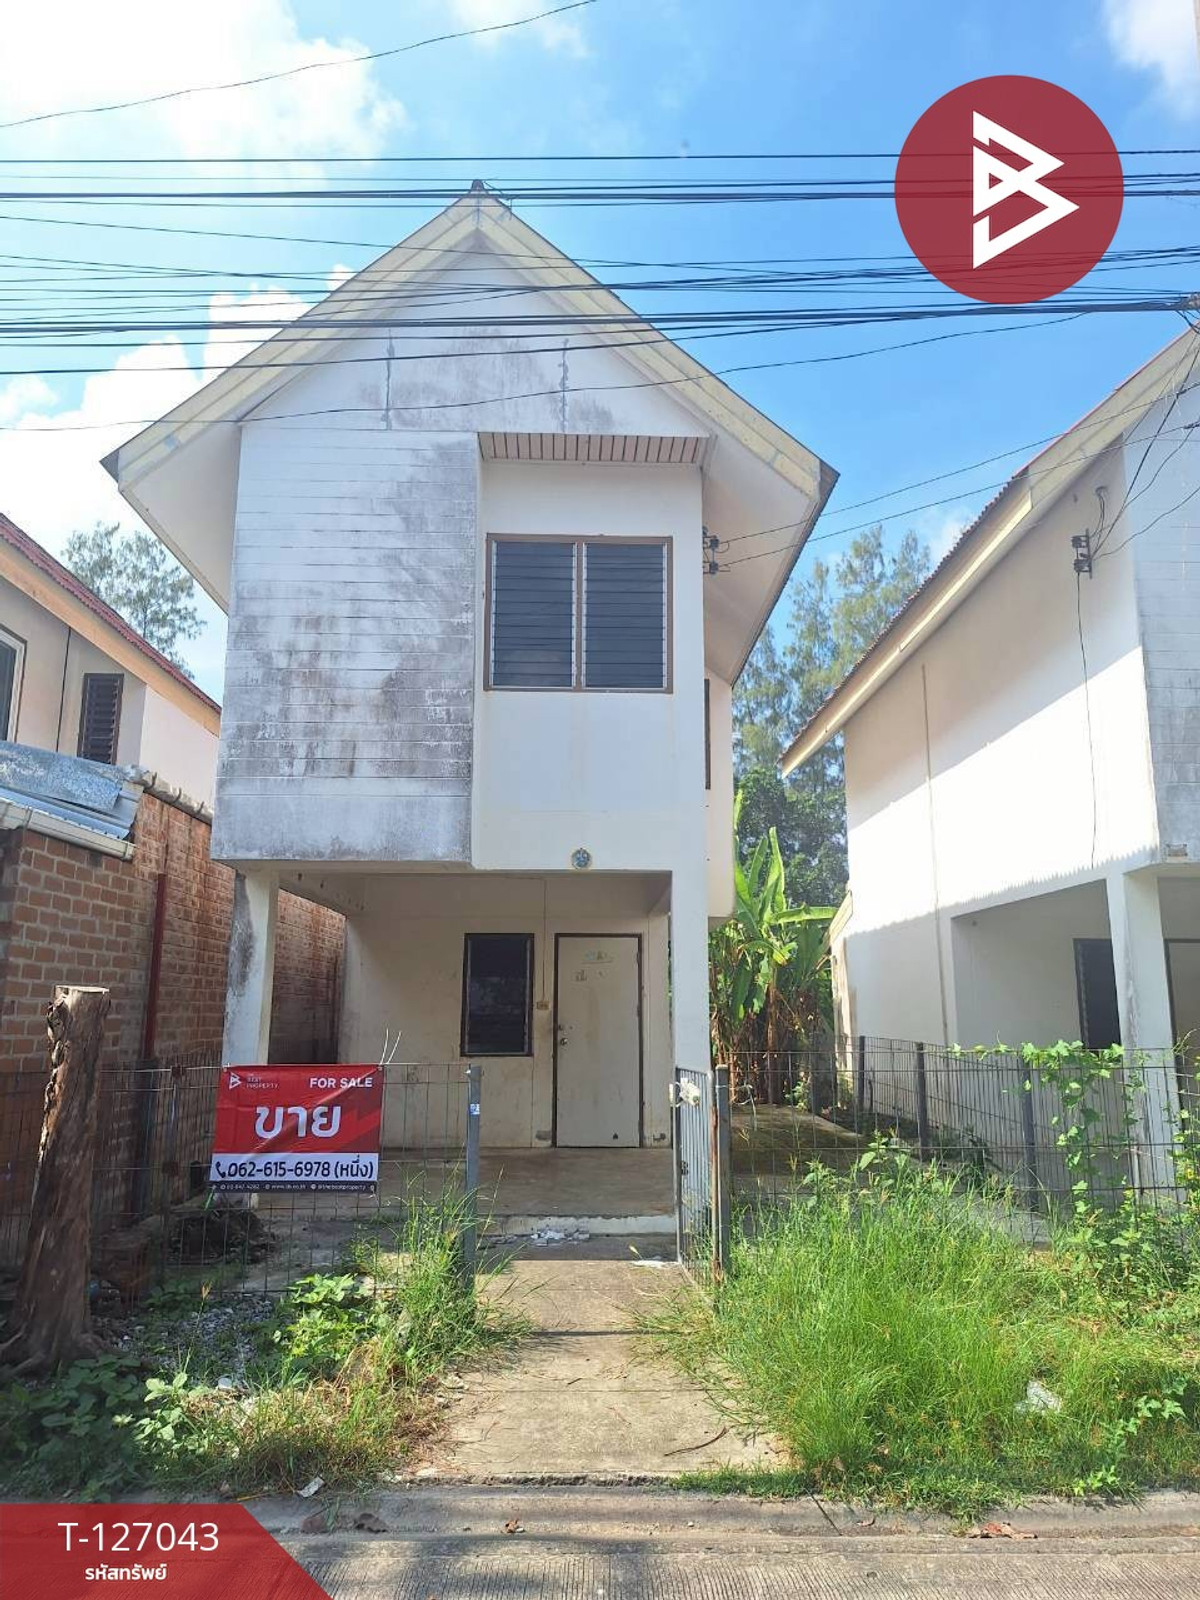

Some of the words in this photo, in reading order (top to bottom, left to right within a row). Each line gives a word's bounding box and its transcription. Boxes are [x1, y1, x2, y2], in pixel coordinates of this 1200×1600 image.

[310, 1077, 336, 1088] FOR
[339, 1077, 373, 1089] SALE
[255, 1106, 341, 1138] ขาย
[227, 1161, 330, 1178] 062-615-6978
[334, 1154, 373, 1178] (หนึ่ง)
